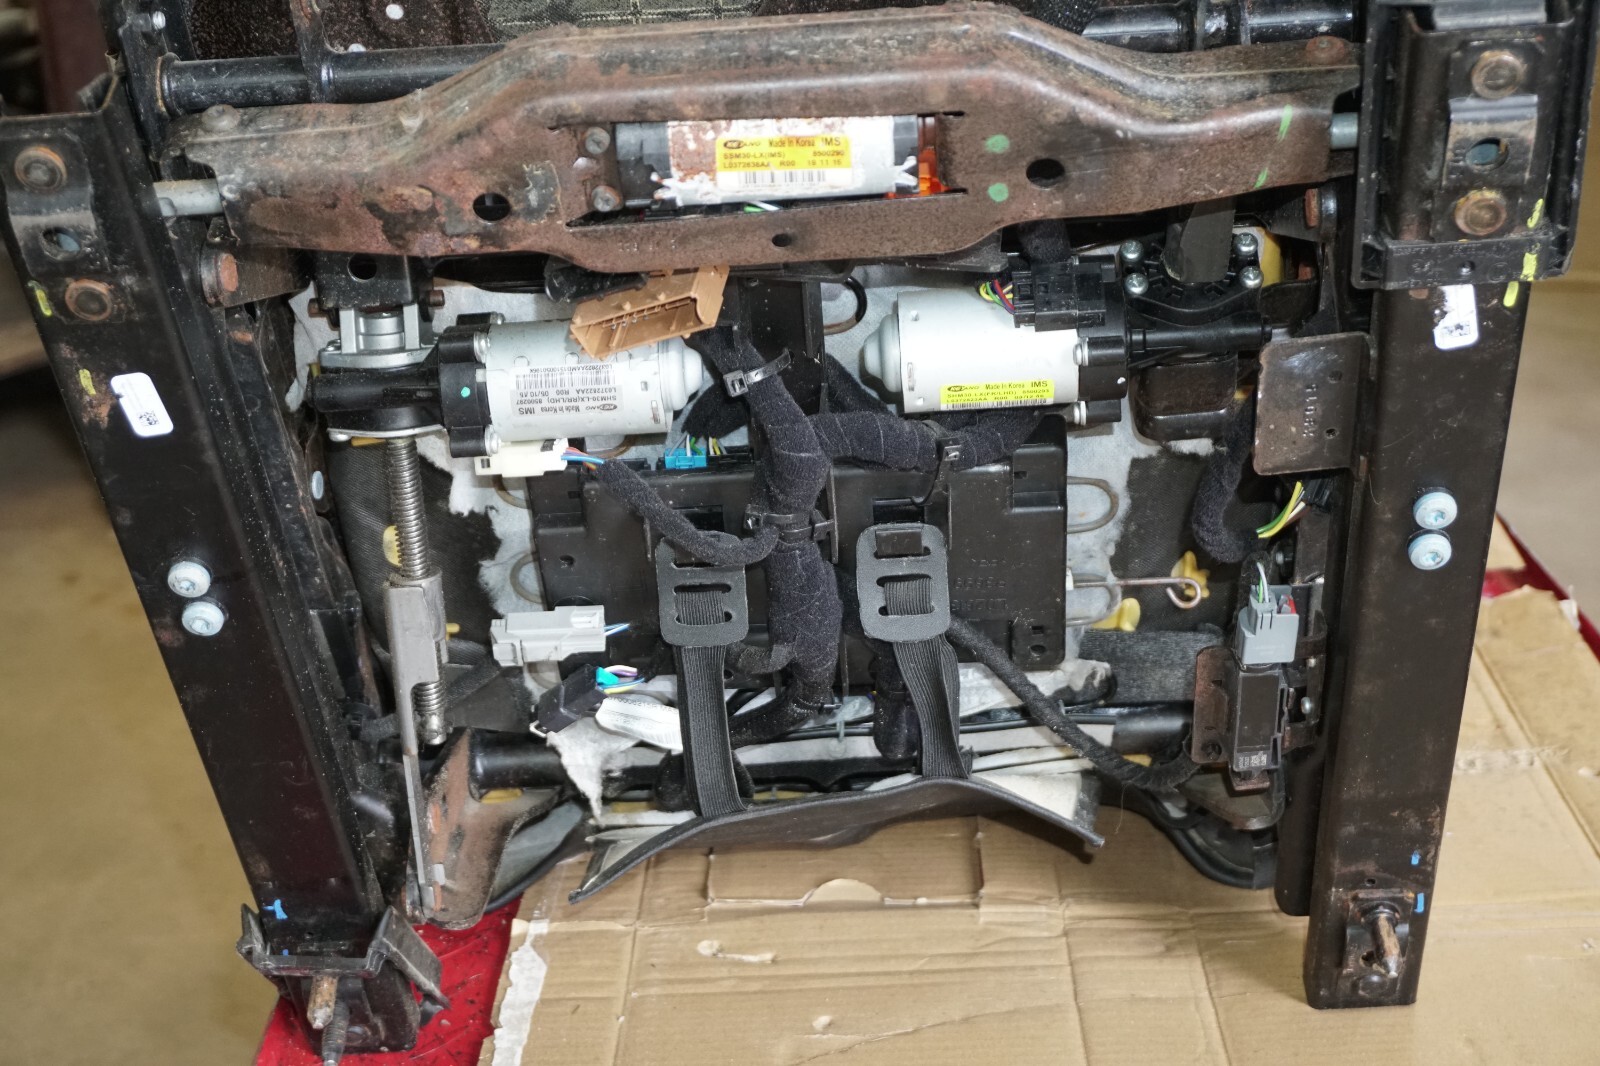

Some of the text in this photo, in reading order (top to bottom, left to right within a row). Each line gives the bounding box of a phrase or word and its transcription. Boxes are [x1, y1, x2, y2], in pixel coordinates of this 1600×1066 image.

[768, 137, 786, 147] Made
[795, 136, 816, 147] Korea
[821, 136, 841, 146] IMS
[1031, 380, 1048, 388] IMS
[518, 406, 535, 415] IMS
[540, 406, 558, 414] Korea
[565, 405, 580, 413] Made
